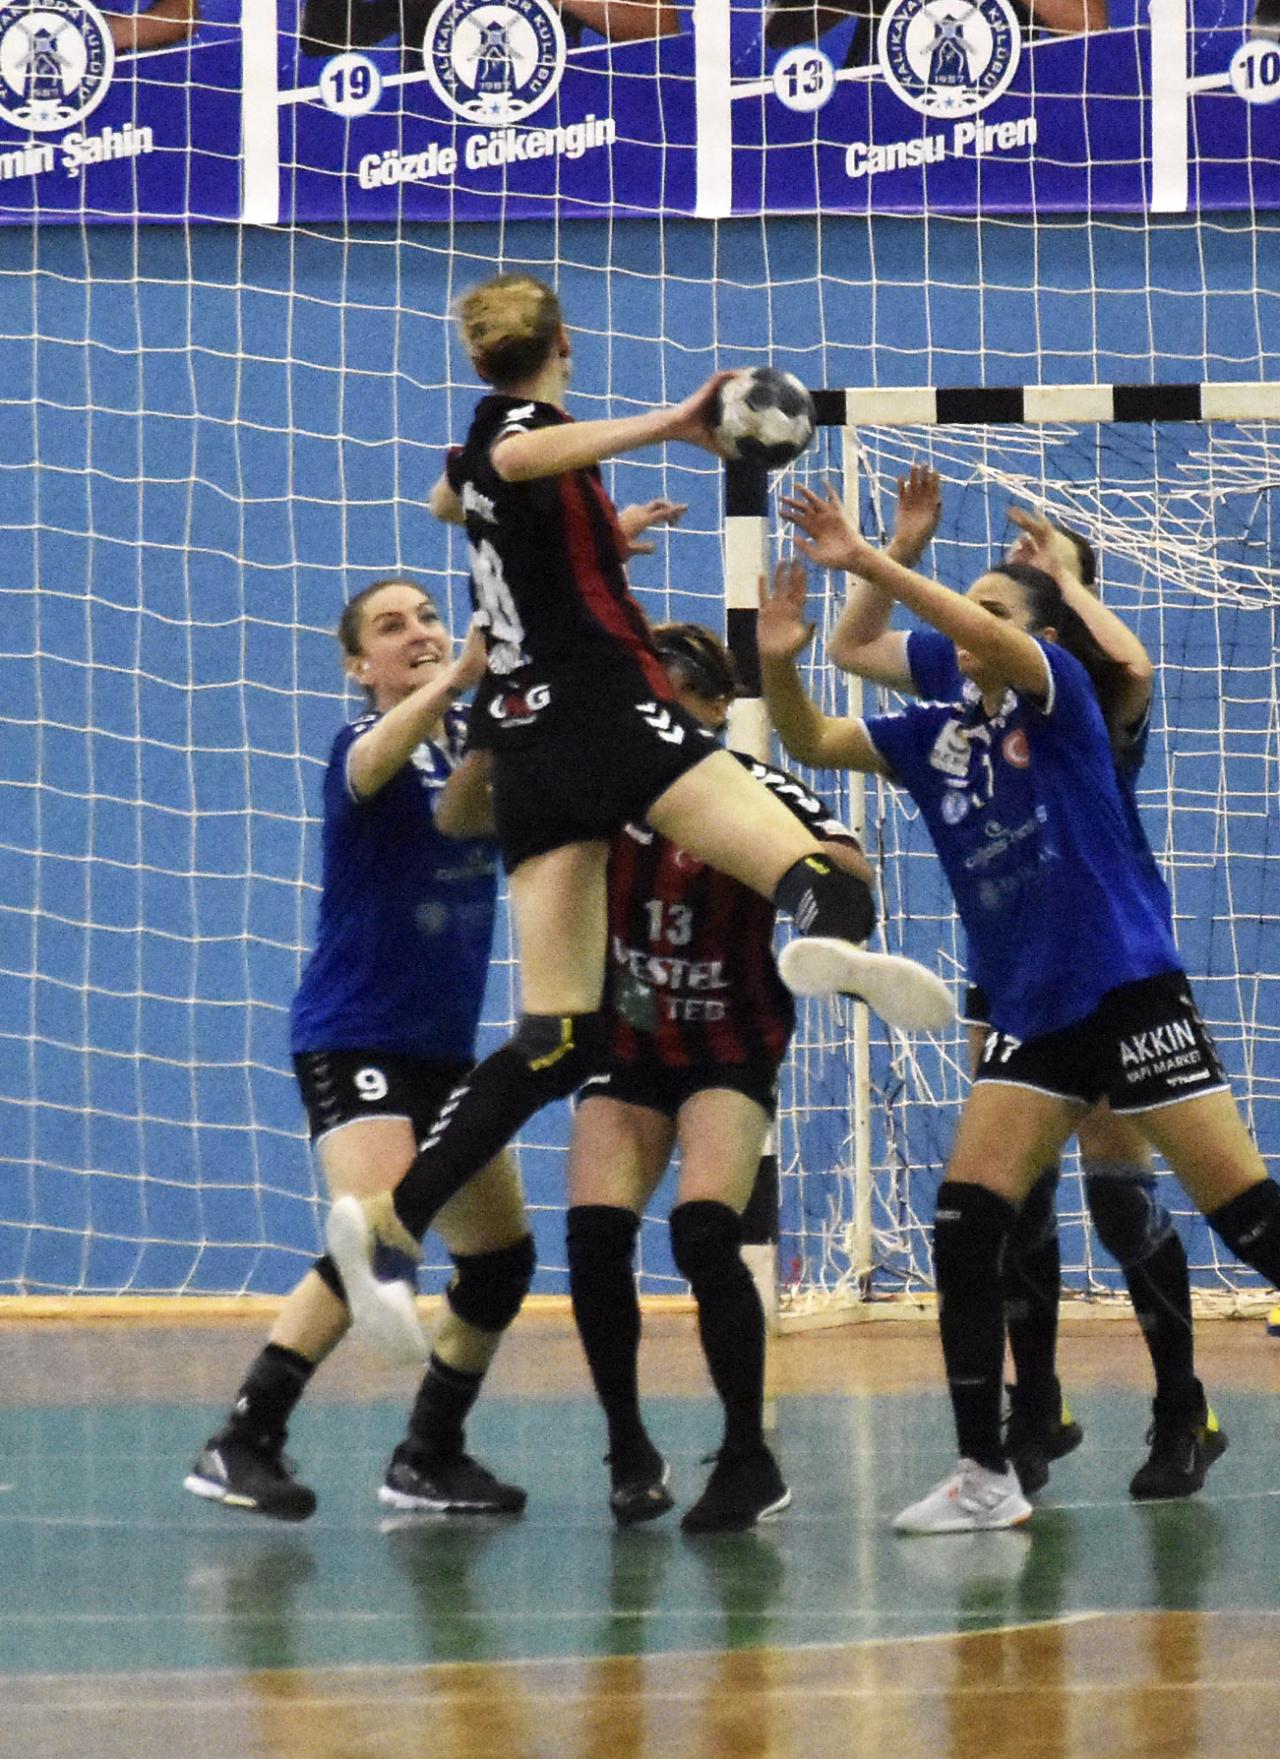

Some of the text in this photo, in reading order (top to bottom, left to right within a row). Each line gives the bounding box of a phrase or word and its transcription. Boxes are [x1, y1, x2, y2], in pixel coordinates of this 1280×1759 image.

[329, 66, 371, 103] 19
[783, 59, 823, 98] 13
[61, 122, 153, 178] Şahin
[359, 114, 616, 190] Gözde Gökengin
[845, 117, 1038, 178] Cansu Piren
[643, 899, 693, 946] 13
[984, 1031, 1023, 1063] 17
[1119, 1019, 1197, 1069] AKKIN
[1153, 1050, 1203, 1076] MARKET
[354, 1066, 389, 1101] 9
